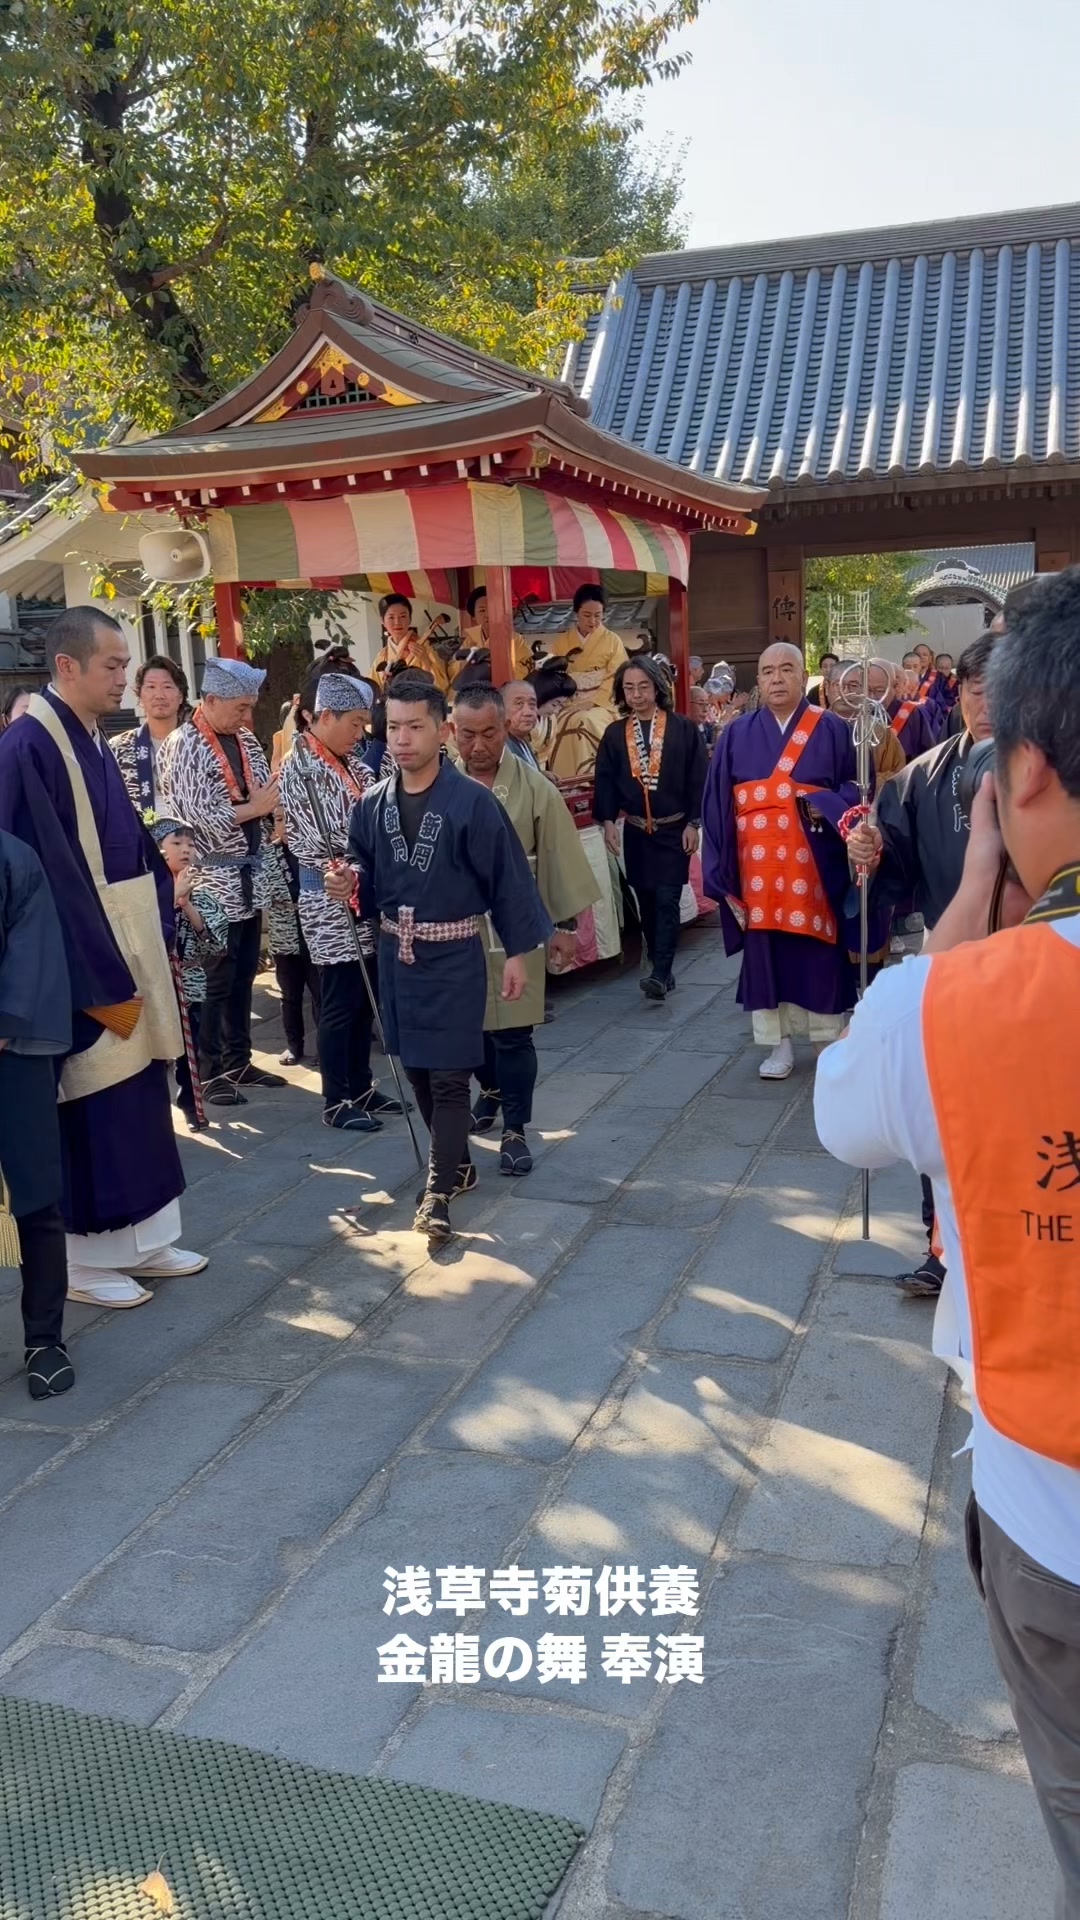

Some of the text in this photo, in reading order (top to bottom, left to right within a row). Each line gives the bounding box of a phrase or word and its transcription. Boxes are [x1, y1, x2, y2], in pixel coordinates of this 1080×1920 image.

[384, 805, 409, 863] 新門
[409, 811, 443, 872] 新門
[1019, 1209, 1074, 1242] THE
